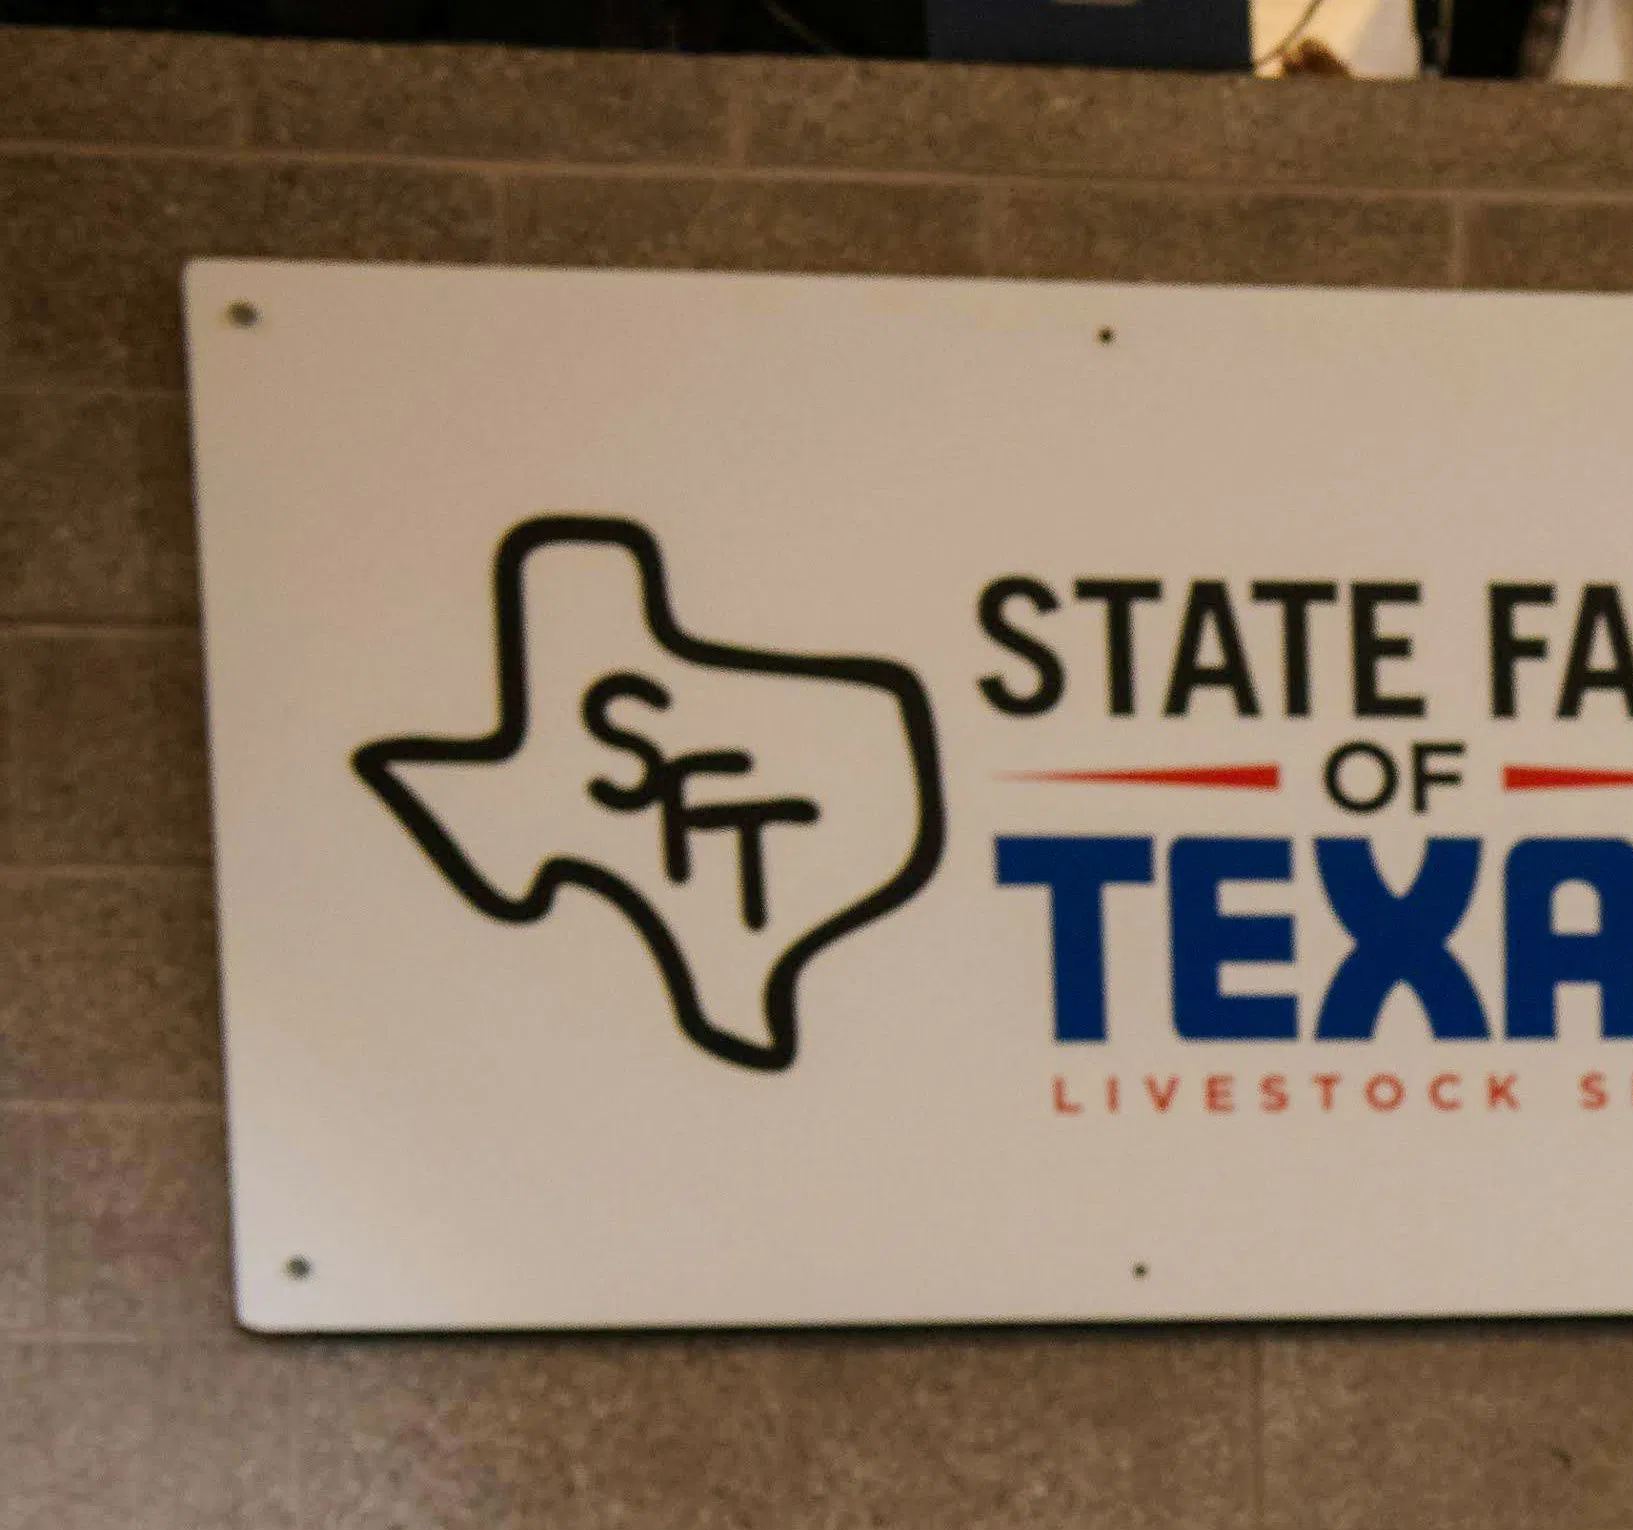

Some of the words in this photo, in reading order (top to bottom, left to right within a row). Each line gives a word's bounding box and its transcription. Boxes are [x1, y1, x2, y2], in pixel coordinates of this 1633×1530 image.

[975, 574, 1428, 721] STATE
[581, 671, 821, 932] SFT
[1321, 738, 1468, 817] OF
[1053, 1073, 1517, 1113] LIVESTOCK
